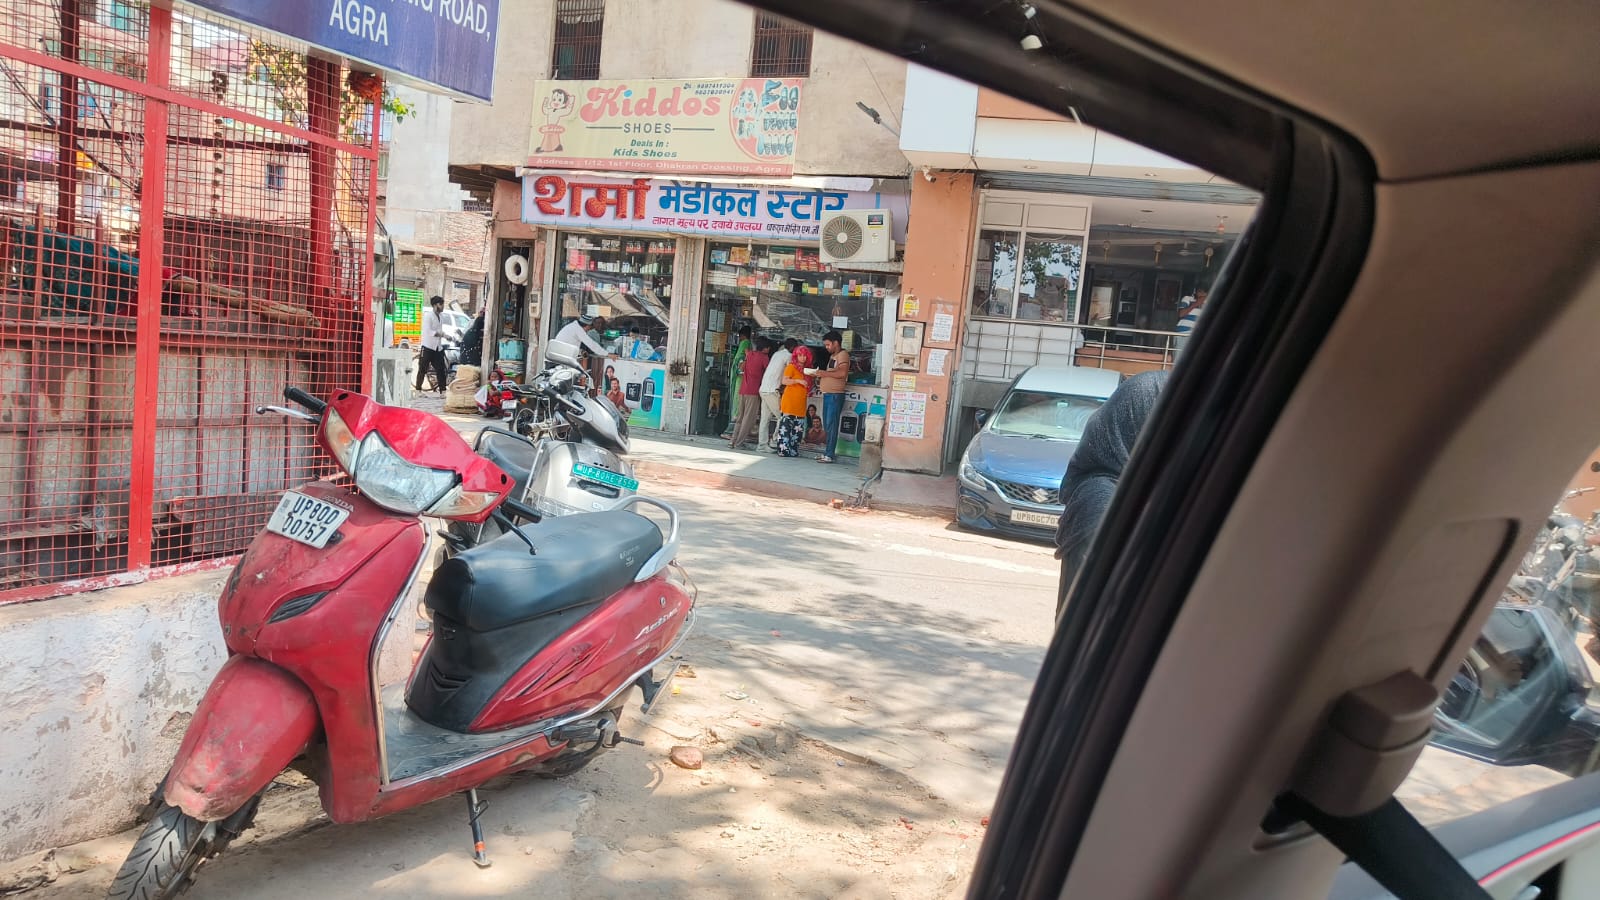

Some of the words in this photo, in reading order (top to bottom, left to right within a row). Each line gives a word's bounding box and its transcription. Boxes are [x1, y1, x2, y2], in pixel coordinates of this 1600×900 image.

[329, 0, 389, 46] AGRA
[580, 85, 721, 123] Kiddos
[623, 123, 672, 134] SHOES
[630, 139, 653, 147] Deals
[613, 149, 638, 157] Kids
[642, 149, 678, 158] Shoes
[655, 162, 698, 170] Dhakran
[701, 163, 753, 173] Crossing,
[756, 166, 782, 174] Agra
[659, 181, 760, 217] मेडीकल
[652, 216, 675, 226] लागत
[697, 219, 709, 230] पर
